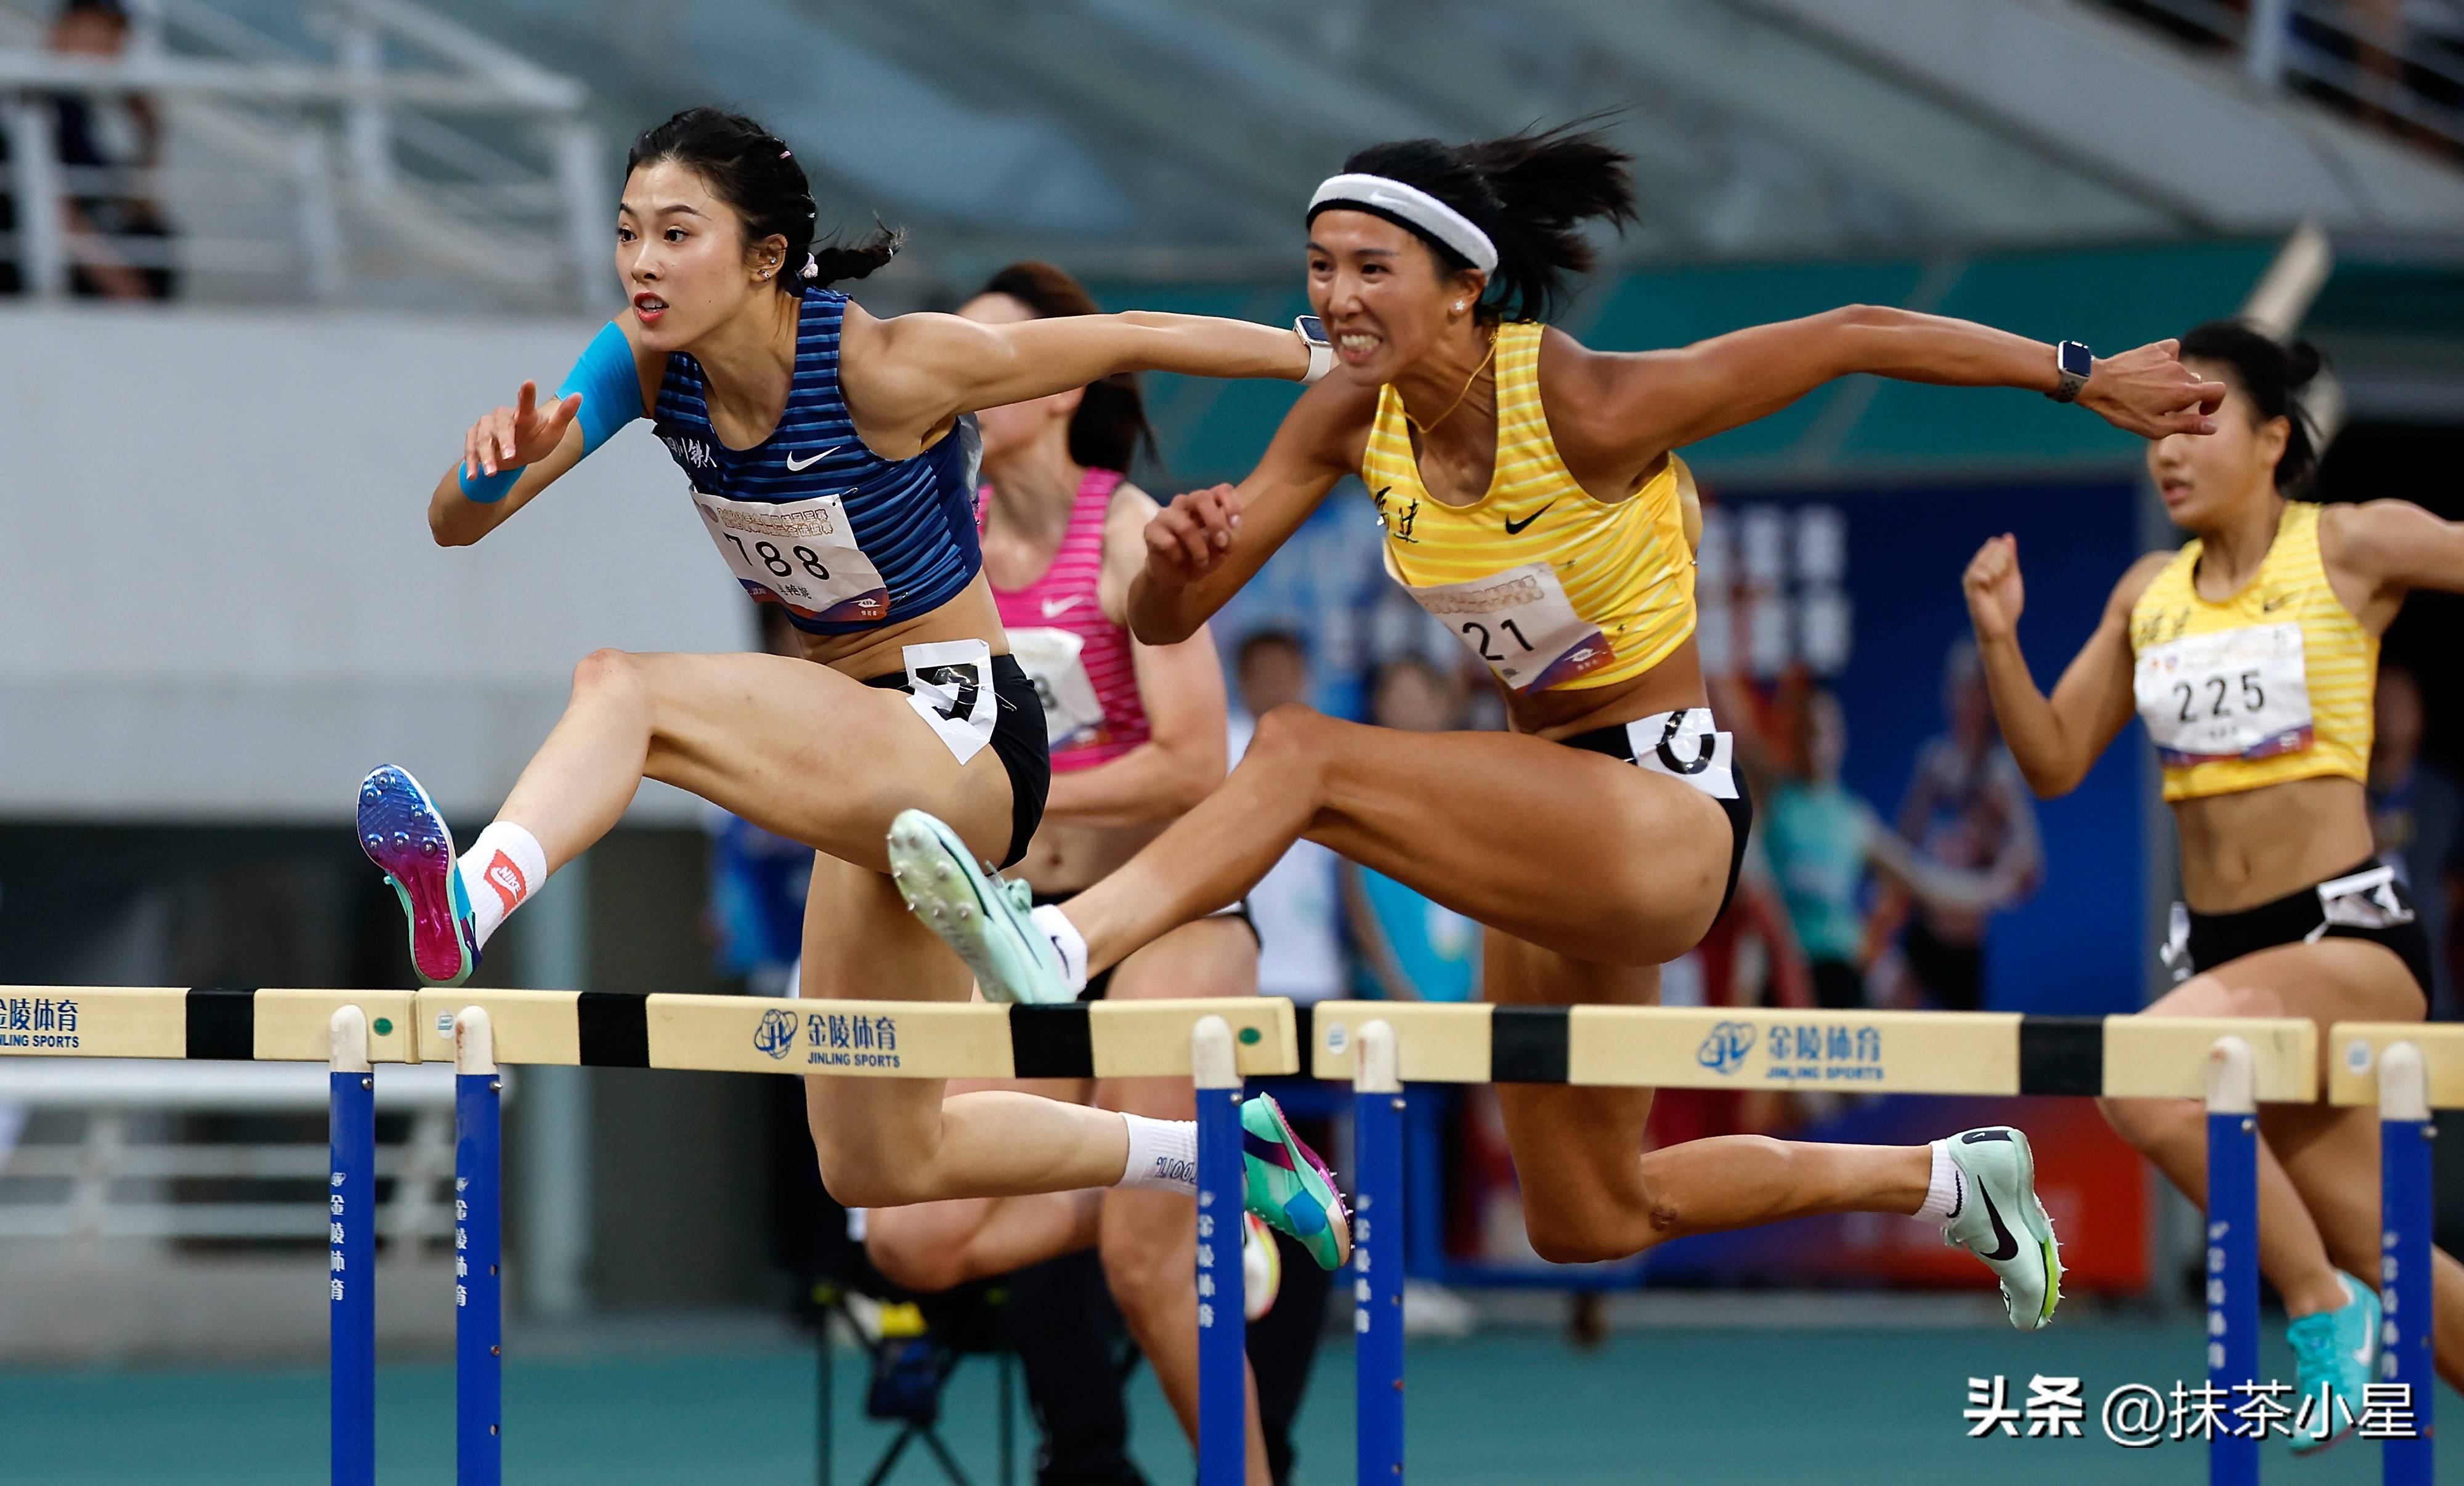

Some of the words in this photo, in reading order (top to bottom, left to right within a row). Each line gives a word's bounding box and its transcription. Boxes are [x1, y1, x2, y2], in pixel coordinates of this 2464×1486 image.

[723, 531, 830, 580] 788
[2173, 669, 2265, 722] 225
[499, 866, 522, 892] NIKE
[33, 1035, 79, 1048] SPORTS
[808, 1014, 897, 1050] 金陵体育
[808, 1052, 850, 1066] JINLING
[855, 1054, 901, 1068] SPORTS
[330, 1193, 345, 1301] 金陵体育
